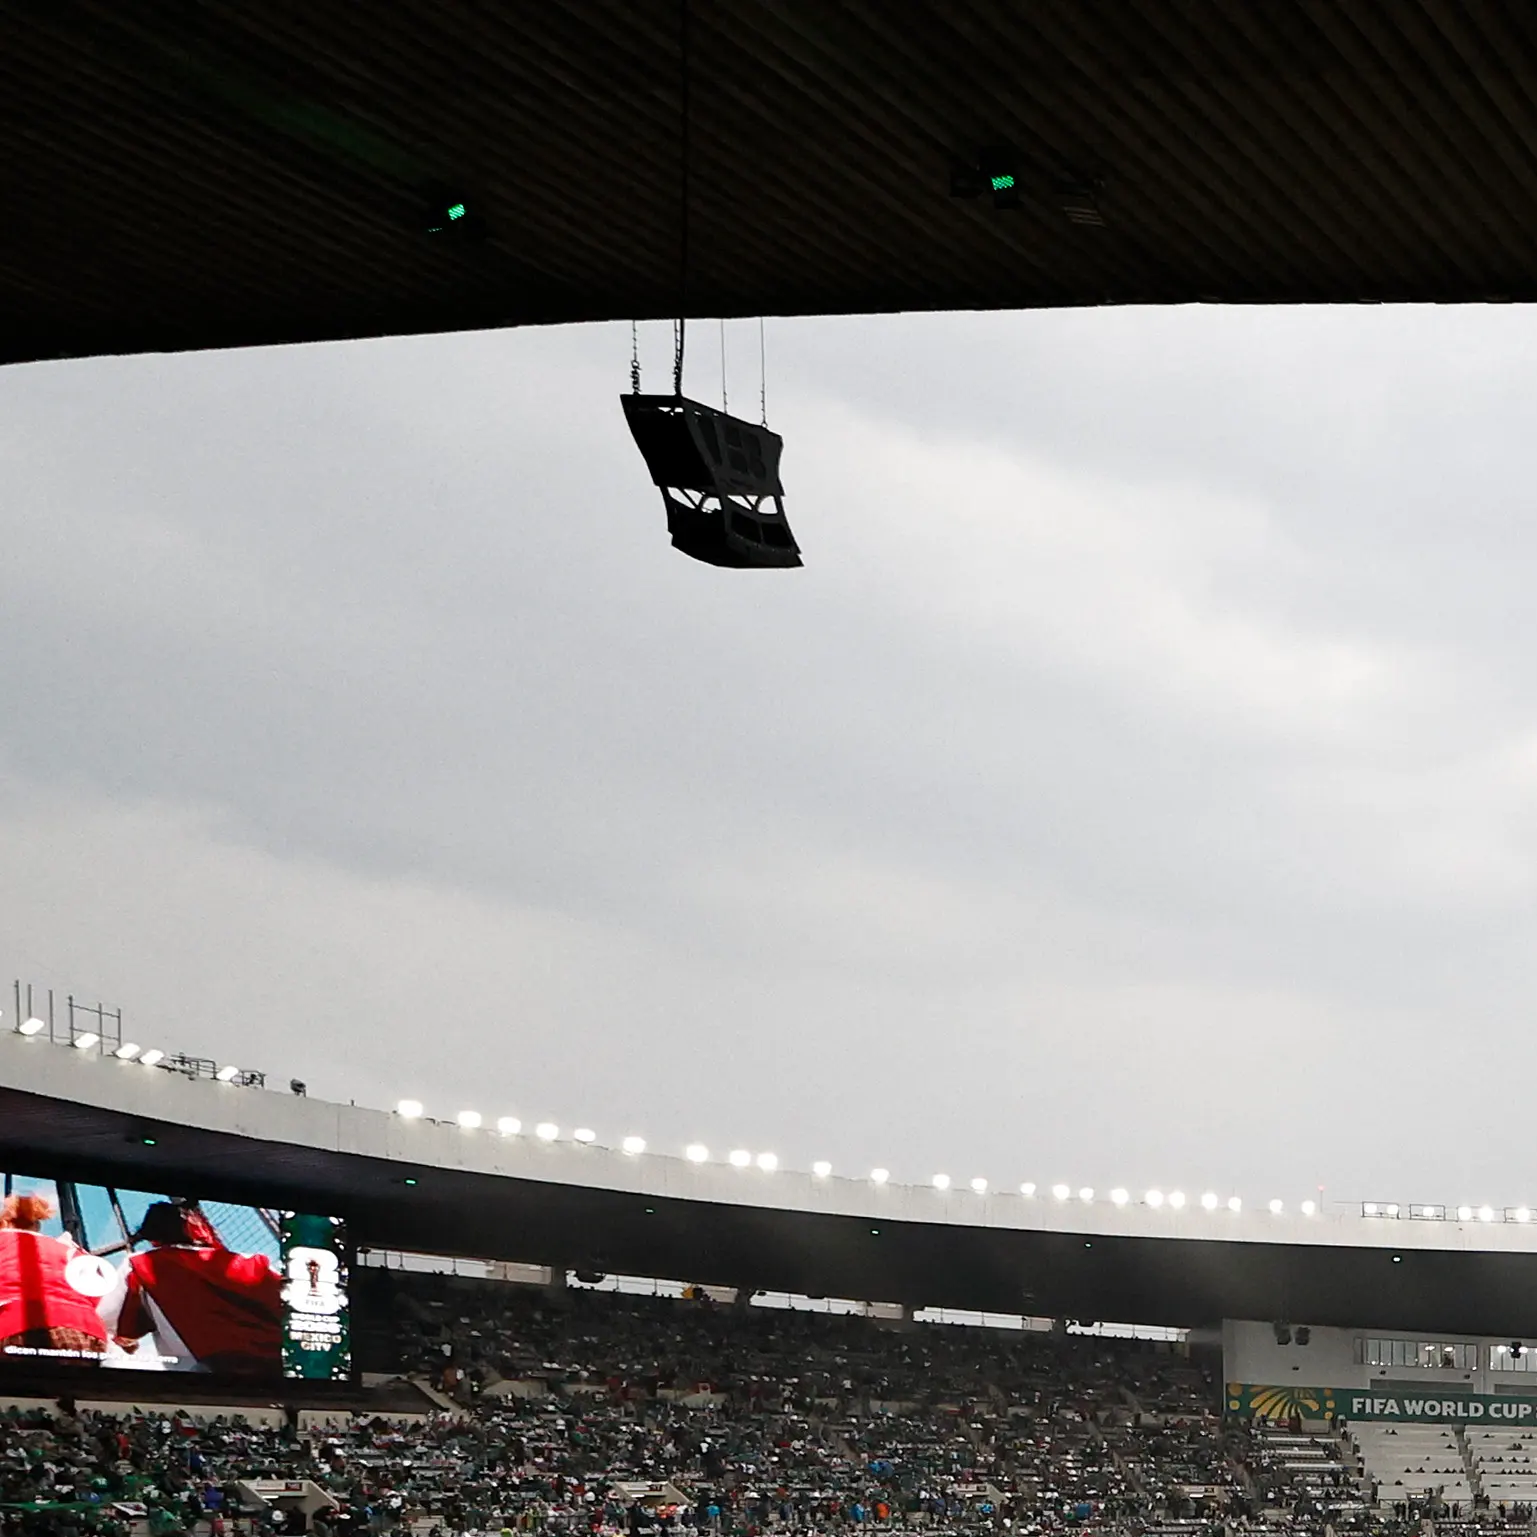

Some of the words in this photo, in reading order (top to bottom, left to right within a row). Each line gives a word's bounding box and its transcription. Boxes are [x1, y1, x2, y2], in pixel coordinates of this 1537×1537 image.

[289, 1331, 342, 1344] MEXICO
[300, 1341, 332, 1352] CITY
[1352, 1397, 1400, 1414] FIFA
[1403, 1399, 1485, 1418] WORLD
[1488, 1403, 1532, 1419] CUP
